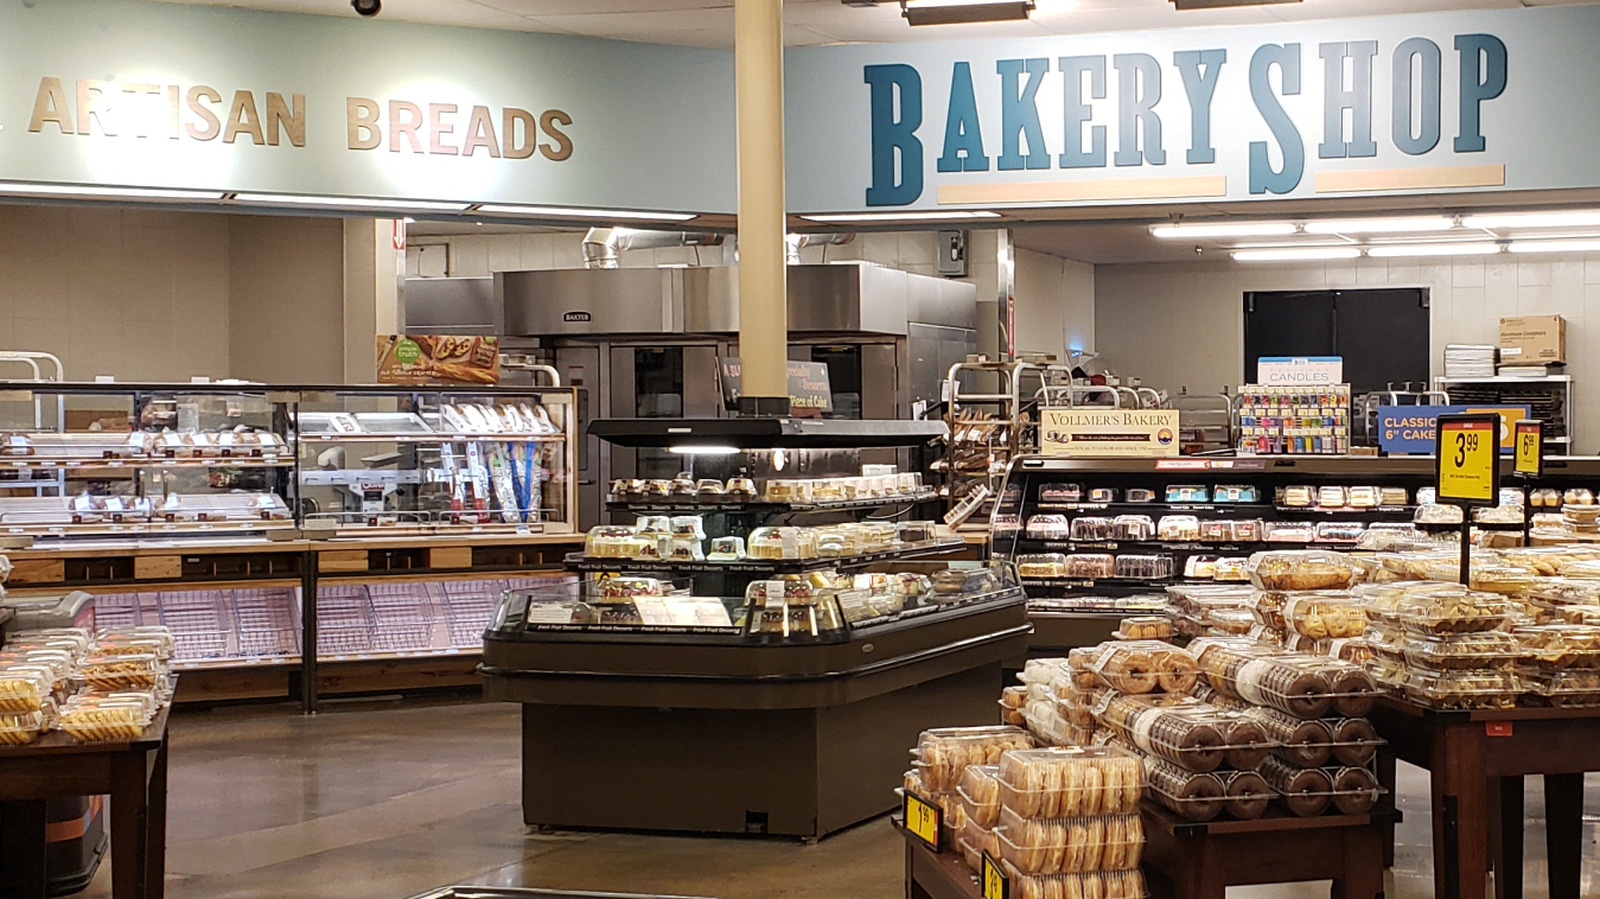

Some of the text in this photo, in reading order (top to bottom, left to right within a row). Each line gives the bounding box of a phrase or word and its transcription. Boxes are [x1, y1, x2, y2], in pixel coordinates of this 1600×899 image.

[28, 76, 573, 162] ARTISAN BREADS
[864, 33, 1507, 206] BAKERY SHOP
[722, 364, 730, 376] A
[1270, 372, 1330, 382] CANDLES
[1050, 412, 1172, 426] VOLLMER'S BAKERY
